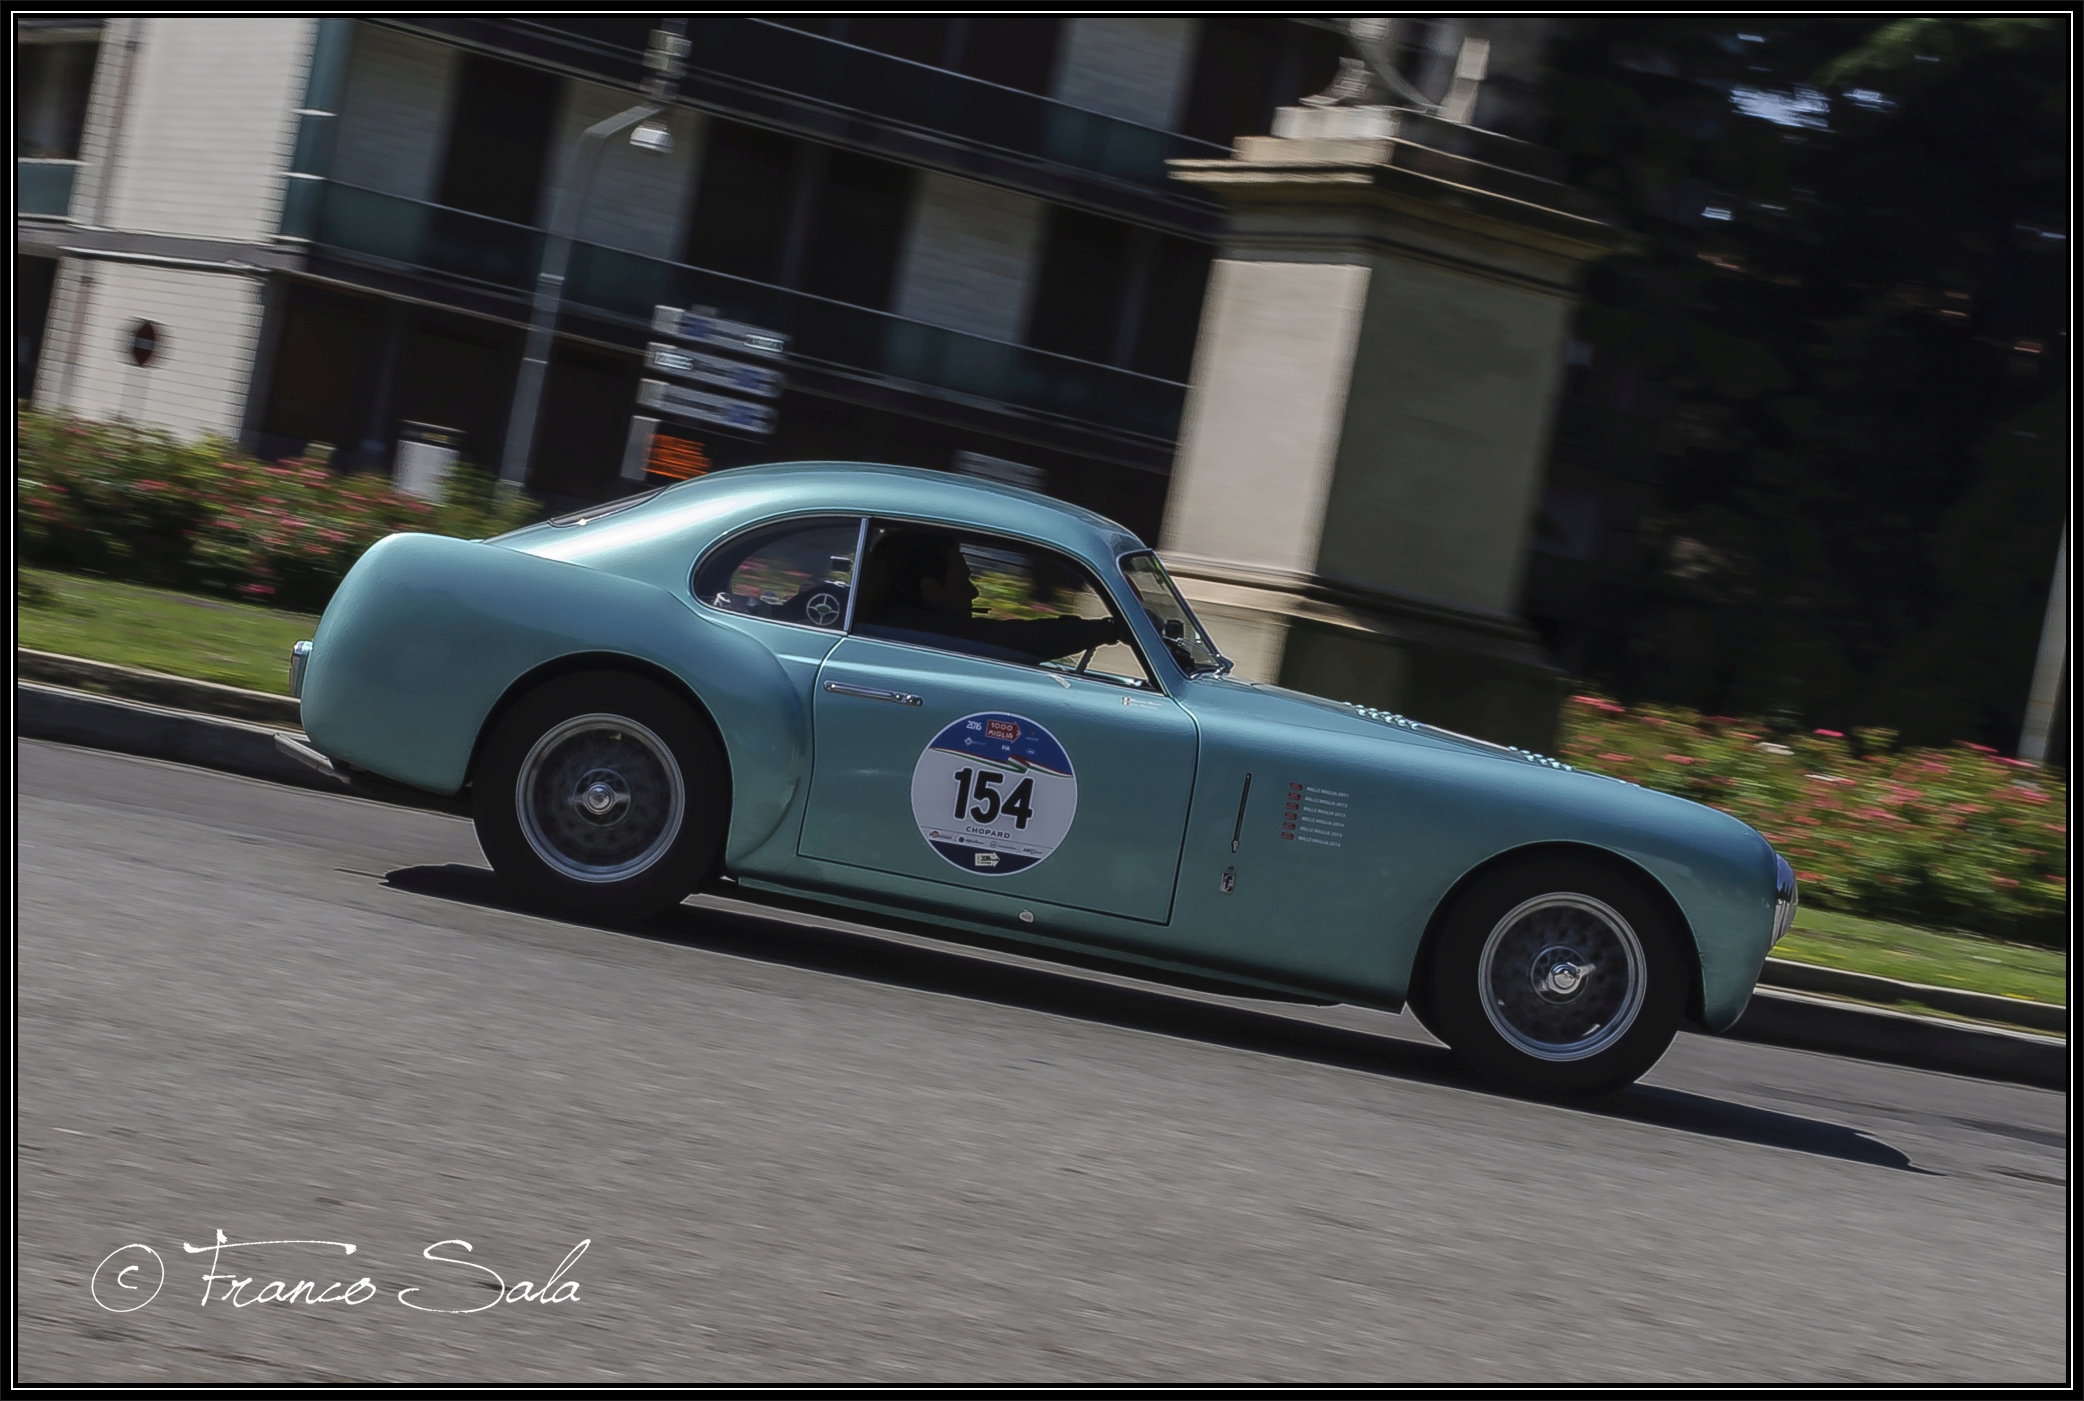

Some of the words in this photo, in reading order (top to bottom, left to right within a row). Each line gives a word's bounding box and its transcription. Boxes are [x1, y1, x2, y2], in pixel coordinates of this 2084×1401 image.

[966, 720, 982, 731] 2016
[991, 722, 1013, 731] 1000
[988, 730, 1013, 739] MIGLIA
[954, 767, 1034, 830] 154
[965, 826, 1011, 839] CHOPARD
